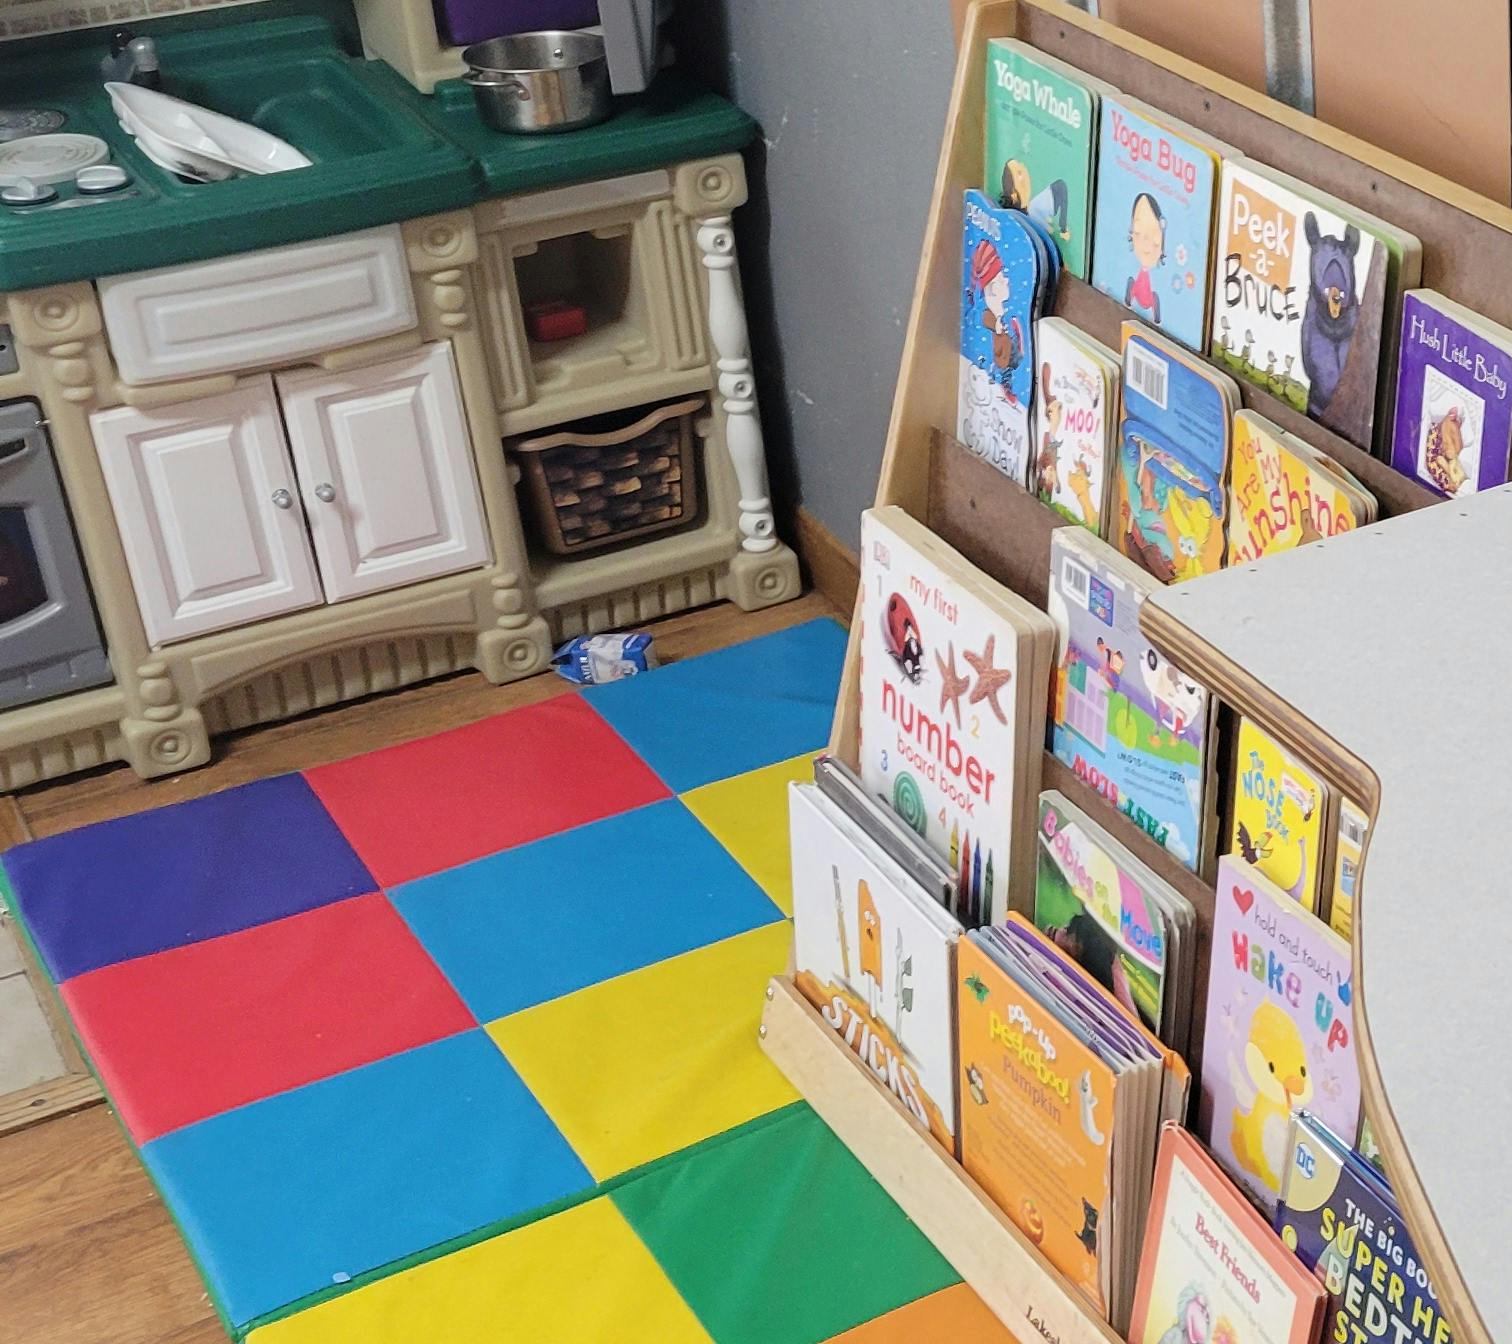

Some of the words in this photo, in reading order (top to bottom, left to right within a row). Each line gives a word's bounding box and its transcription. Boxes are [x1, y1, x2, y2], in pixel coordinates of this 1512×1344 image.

[993, 59, 1032, 102] Yoga
[1031, 79, 1082, 129] Whale
[1110, 109, 1152, 162] Yoga
[1157, 138, 1197, 193] Bug
[1232, 192, 1290, 258] Peek
[1410, 314, 1441, 351] Hush
[1441, 333, 1473, 371] Little
[1473, 353, 1507, 400] Baby
[1237, 436, 1263, 465] You
[1260, 453, 1283, 485] My
[909, 573, 930, 605] my
[932, 584, 960, 626] first
[882, 677, 996, 804] number
[969, 714, 981, 739] 2
[897, 731, 936, 784] board
[939, 769, 975, 819] book
[936, 806, 947, 829] 4
[1254, 904, 1278, 938] hold
[1278, 932, 1300, 956] and
[1301, 947, 1334, 986] touch
[821, 996, 931, 1131] STICKS
[1007, 1003, 1057, 1060] pop-up
[1003, 1055, 1063, 1124] Pumpkin
[1295, 1146, 1316, 1177] DC
[1194, 1210, 1220, 1256] Best
[1219, 1241, 1261, 1305] Friends
[1320, 1207, 1405, 1314] SUPER
[1345, 1197, 1375, 1239] THE
[1376, 1230, 1405, 1268] BIG
[1406, 1256, 1438, 1300] BOO
